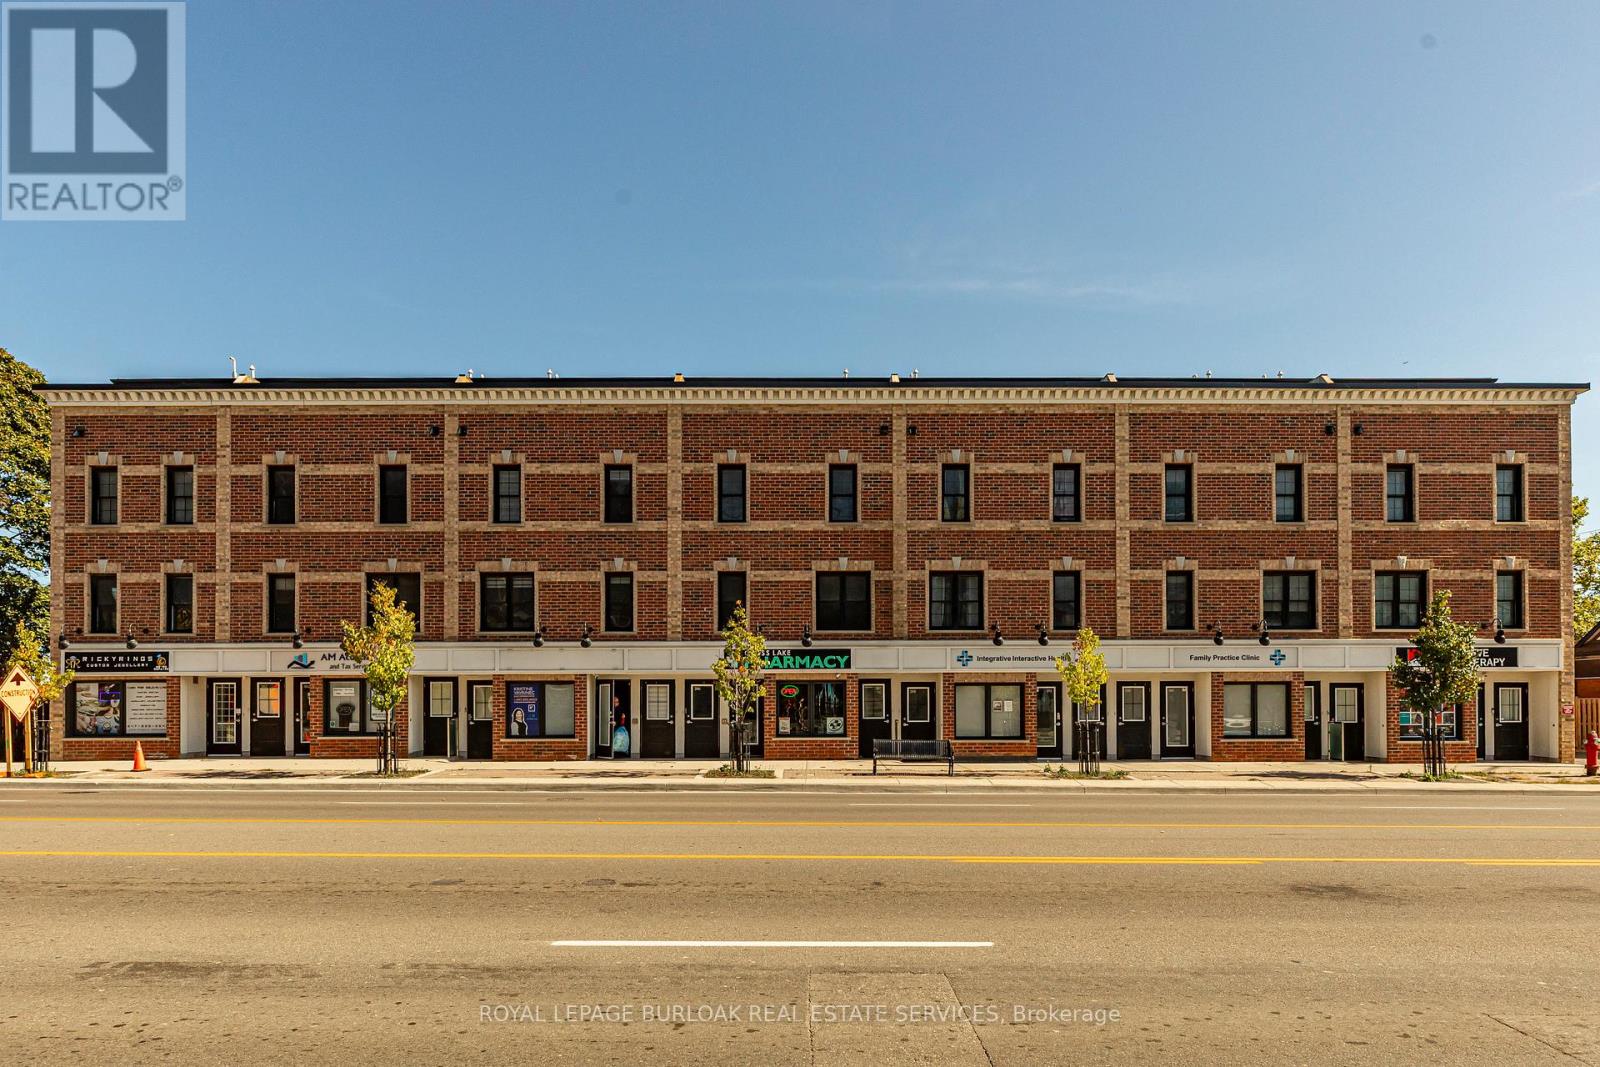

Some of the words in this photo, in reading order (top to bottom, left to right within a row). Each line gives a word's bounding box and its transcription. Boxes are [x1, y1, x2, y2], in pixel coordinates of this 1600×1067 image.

[320, 653, 336, 661] AM
[976, 655, 1011, 663] Integrative
[1189, 654, 1211, 662] Family
[744, 655, 849, 669] ARMACY
